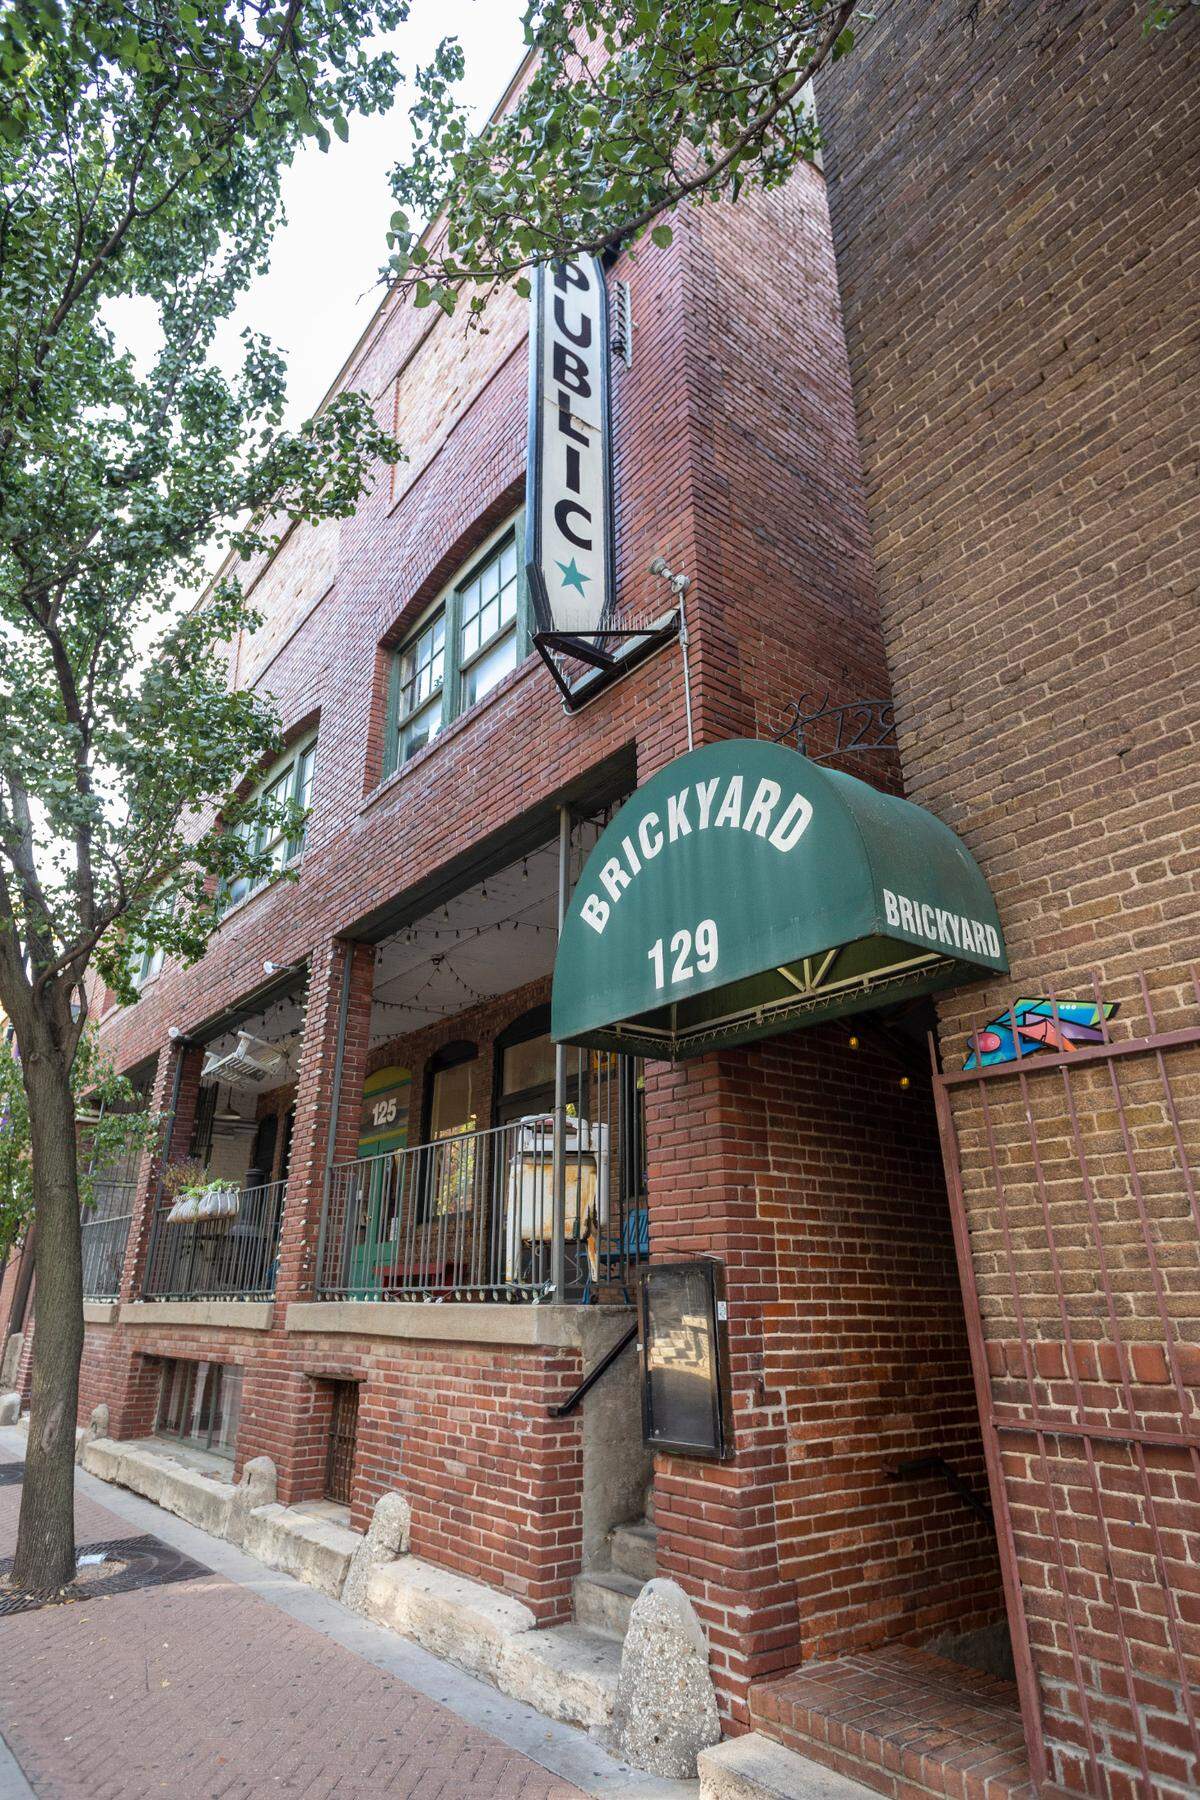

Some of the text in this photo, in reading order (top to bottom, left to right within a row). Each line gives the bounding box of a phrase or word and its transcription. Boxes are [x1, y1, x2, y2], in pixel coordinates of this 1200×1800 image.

[553, 252, 593, 551] PUBLIC
[579, 775, 814, 934] BRICKYARD
[647, 918, 719, 990] 129
[883, 888, 1001, 958] BRICKYARD
[372, 1098, 397, 1126] 125
